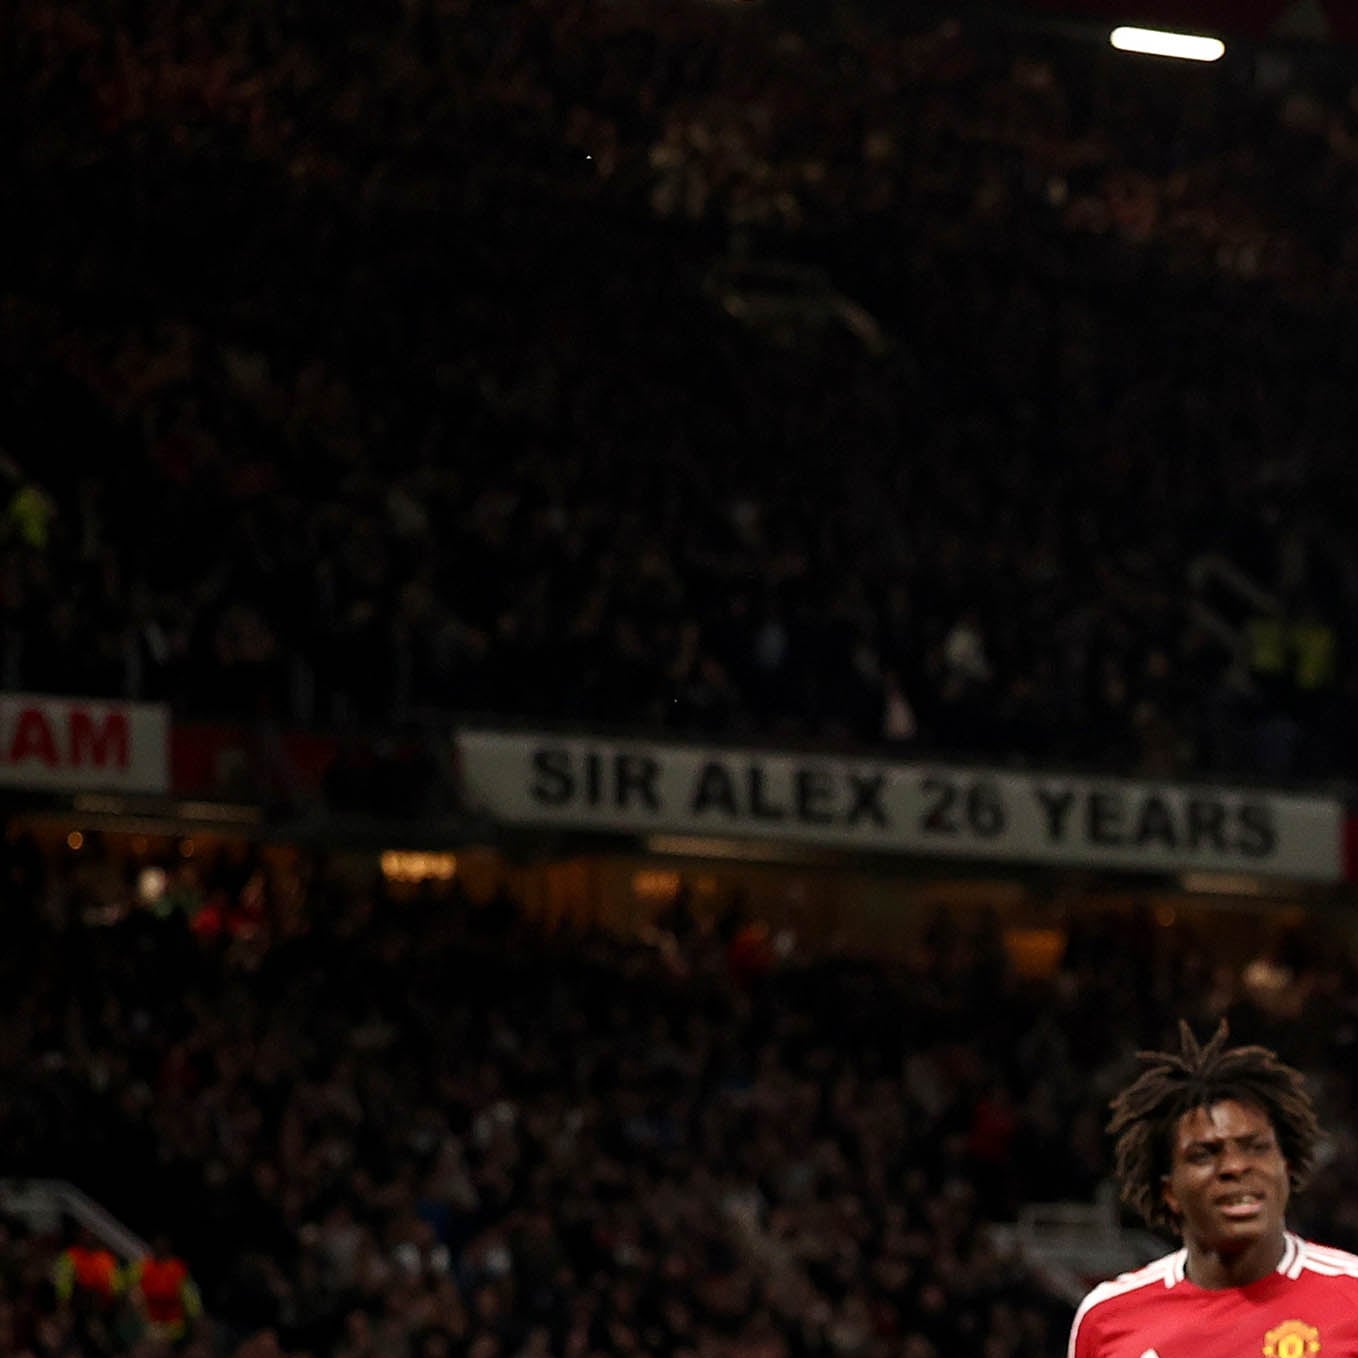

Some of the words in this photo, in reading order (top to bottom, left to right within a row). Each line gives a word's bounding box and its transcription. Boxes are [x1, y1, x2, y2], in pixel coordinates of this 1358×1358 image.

[531, 750, 662, 812] SIR
[692, 762, 888, 826] ALEX
[918, 778, 1007, 838] 26
[1038, 790, 1279, 857] YEARS
